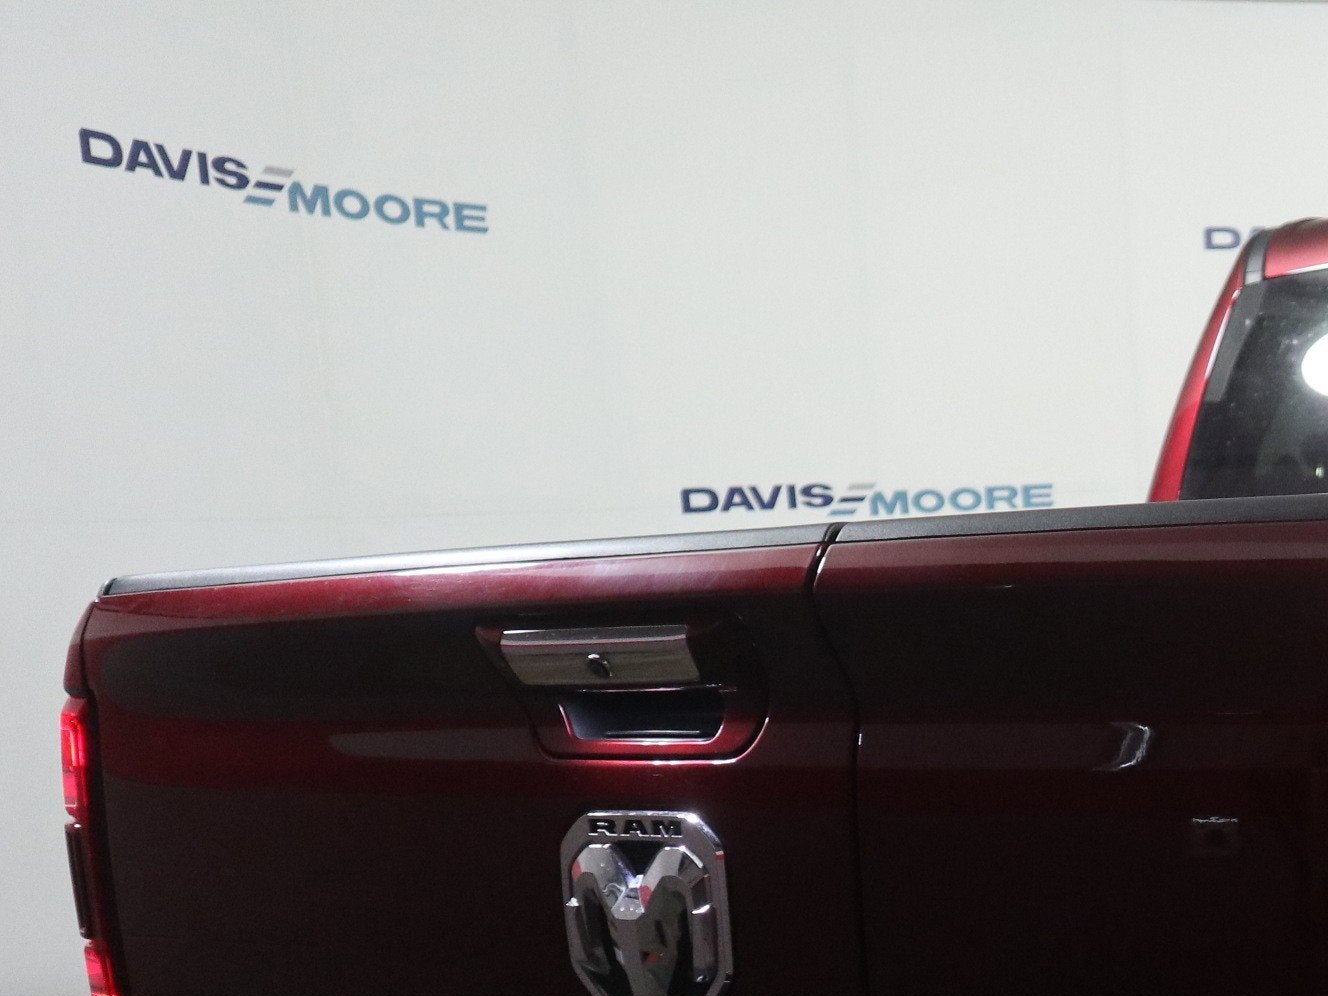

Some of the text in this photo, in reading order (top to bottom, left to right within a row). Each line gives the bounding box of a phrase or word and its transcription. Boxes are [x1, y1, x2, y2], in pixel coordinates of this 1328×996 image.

[79, 127, 489, 234] DAVIS MOORE
[1203, 226, 1264, 250] D
[680, 483, 1054, 516] DAVIS MOORE
[588, 818, 683, 838] RAM
